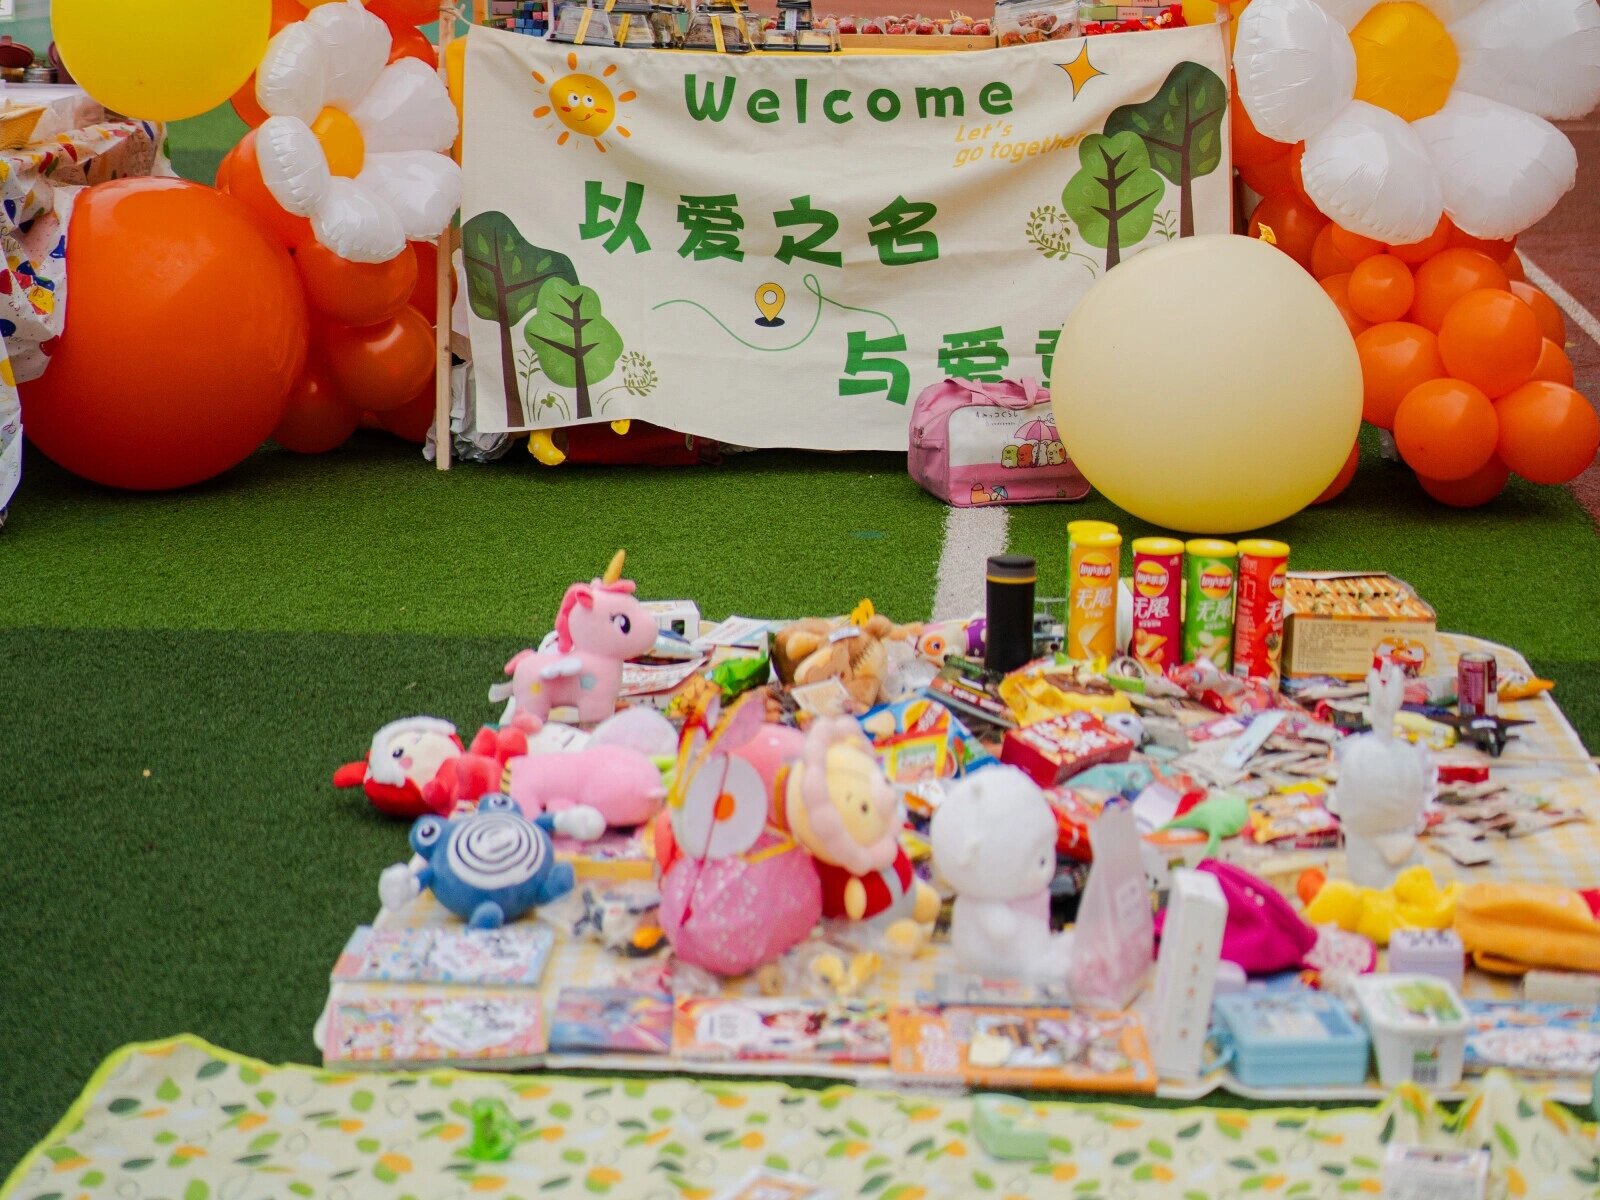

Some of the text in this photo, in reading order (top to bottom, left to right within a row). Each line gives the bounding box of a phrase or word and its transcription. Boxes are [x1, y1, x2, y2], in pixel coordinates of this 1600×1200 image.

[684, 73, 1014, 124] Welcome
[955, 120, 1013, 143] Let's
[953, 132, 1088, 168] go together
[578, 180, 940, 268] 以爱之名
[1076, 587, 1112, 610] 无限
[1134, 596, 1170, 619] 无限
